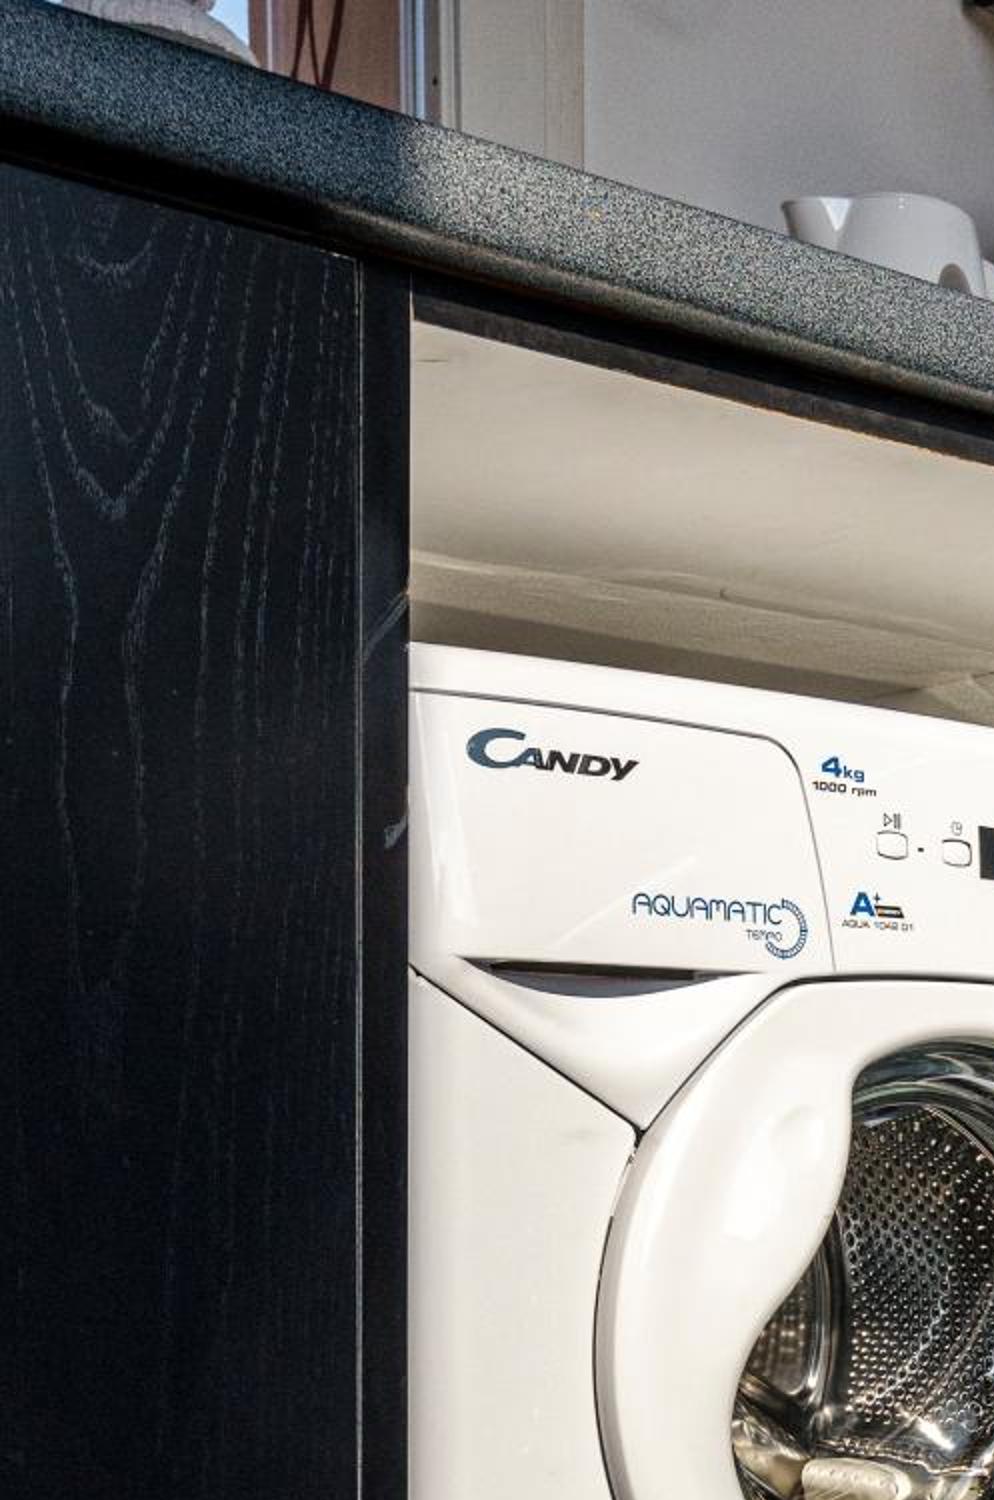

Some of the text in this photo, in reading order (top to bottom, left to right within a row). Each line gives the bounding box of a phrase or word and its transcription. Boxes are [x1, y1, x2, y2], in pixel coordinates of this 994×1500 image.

[466, 728, 640, 781] CANDY
[821, 756, 865, 783] 4kg
[812, 780, 877, 797] 1000 rpm
[632, 892, 783, 925] AQUAMATIC
[841, 919, 871, 929] AQUA
[746, 929, 783, 943] TEMPO
